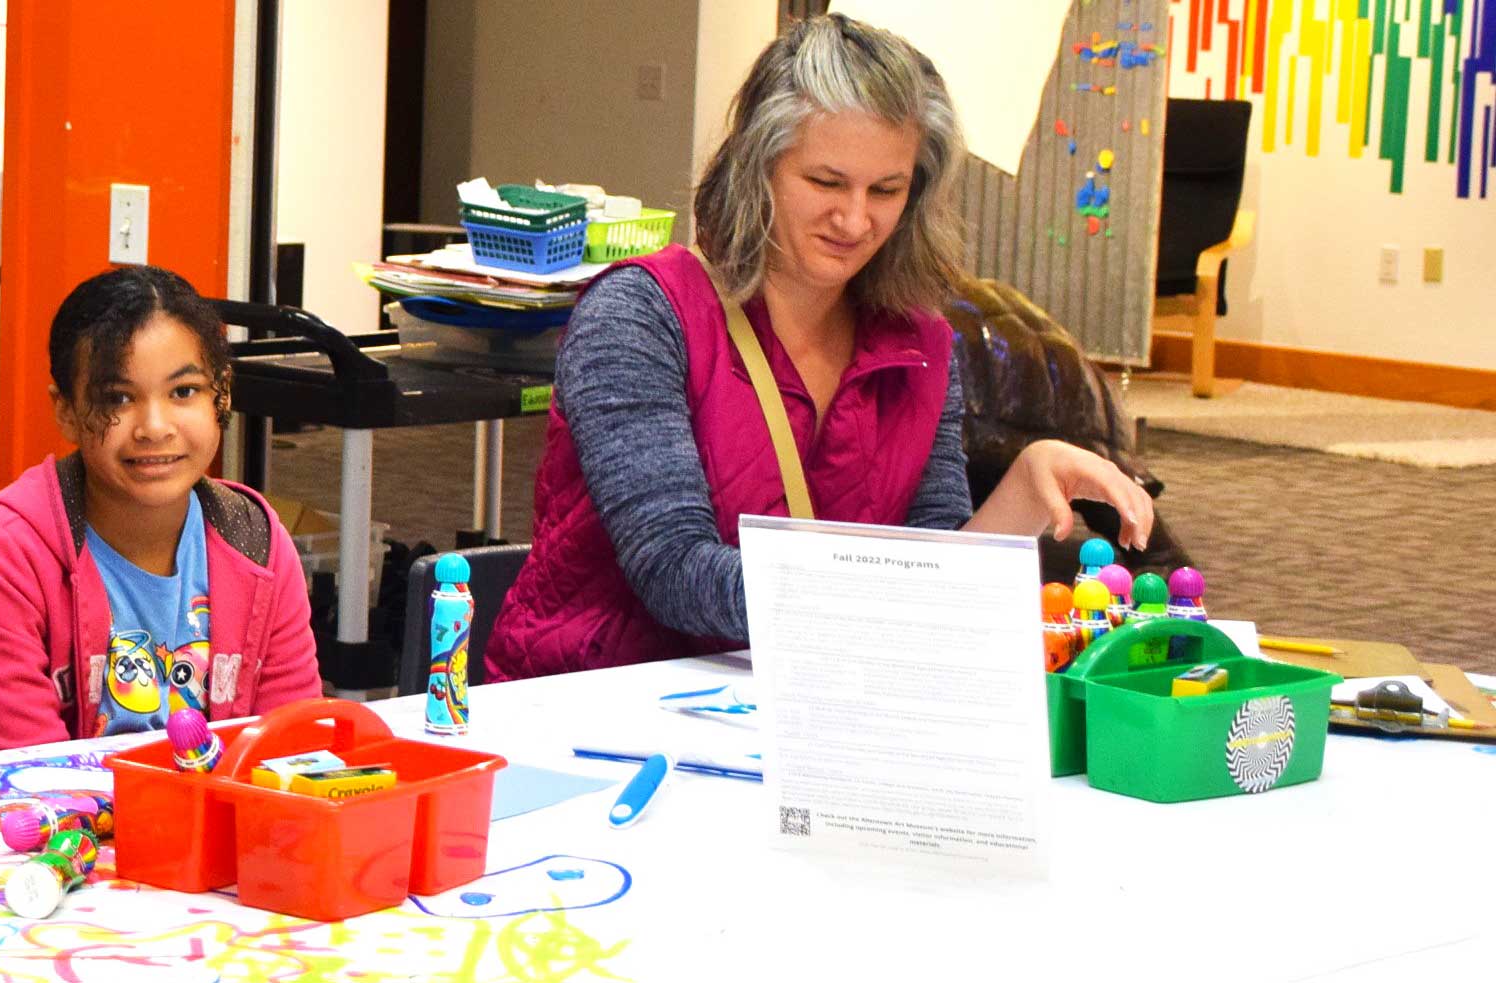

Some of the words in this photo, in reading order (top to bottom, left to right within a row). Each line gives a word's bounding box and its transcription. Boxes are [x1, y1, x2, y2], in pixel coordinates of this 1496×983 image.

[833, 552, 853, 562] Fall
[855, 555, 881, 565] 2022
[884, 557, 941, 570] Programs
